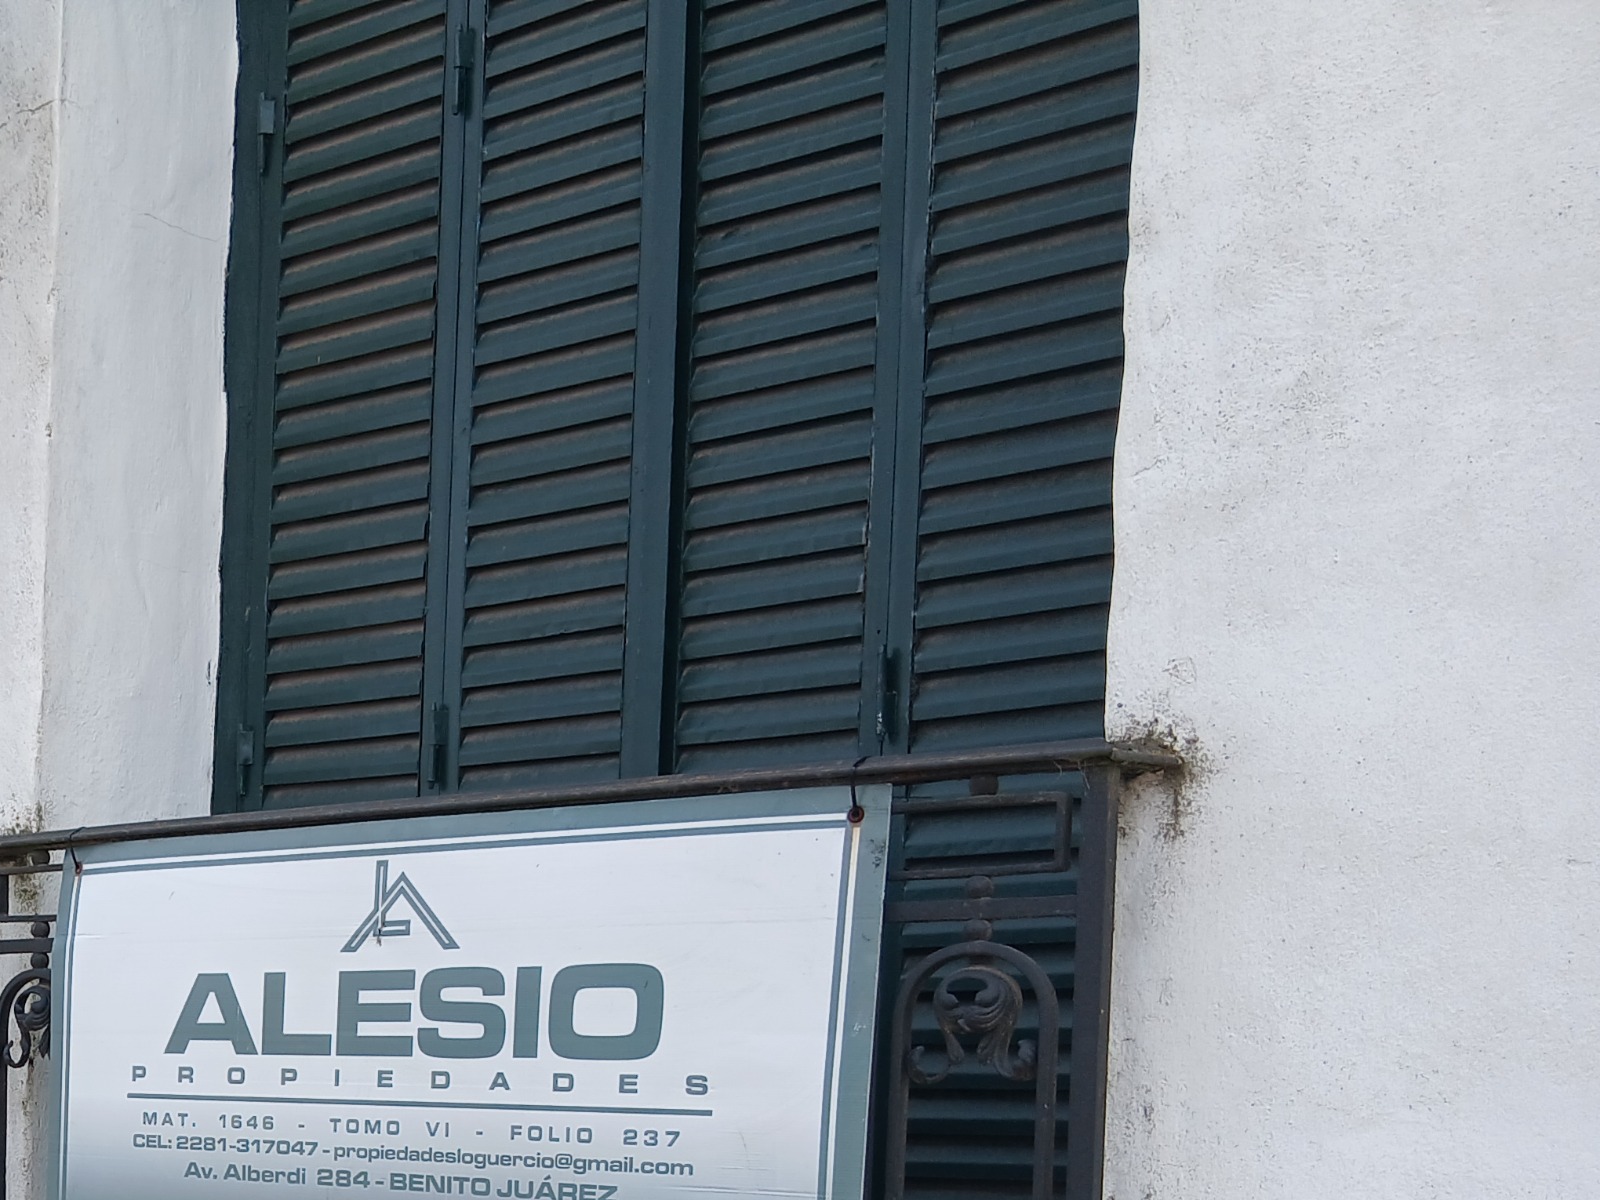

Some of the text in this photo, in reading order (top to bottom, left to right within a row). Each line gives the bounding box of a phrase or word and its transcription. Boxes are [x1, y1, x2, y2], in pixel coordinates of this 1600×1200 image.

[164, 963, 664, 1060] ALESIO
[131, 1065, 709, 1096] PROPIEDADES
[142, 1111, 196, 1127] MAT.
[219, 1114, 274, 1130] 1646
[329, 1118, 400, 1135] TOMO
[426, 1121, 450, 1137] VI
[509, 1125, 593, 1143] FOLIO
[622, 1129, 681, 1147] 237
[132, 1133, 172, 1149] CEL:
[176, 1136, 318, 1156] 2281-317047
[333, 1145, 694, 1176] propiedadesloguercio@gmail.com
[184, 1161, 218, 1179] Av.
[223, 1164, 306, 1185] Alberdi
[317, 1168, 370, 1188] 284
[389, 1173, 491, 1196] BENITO
